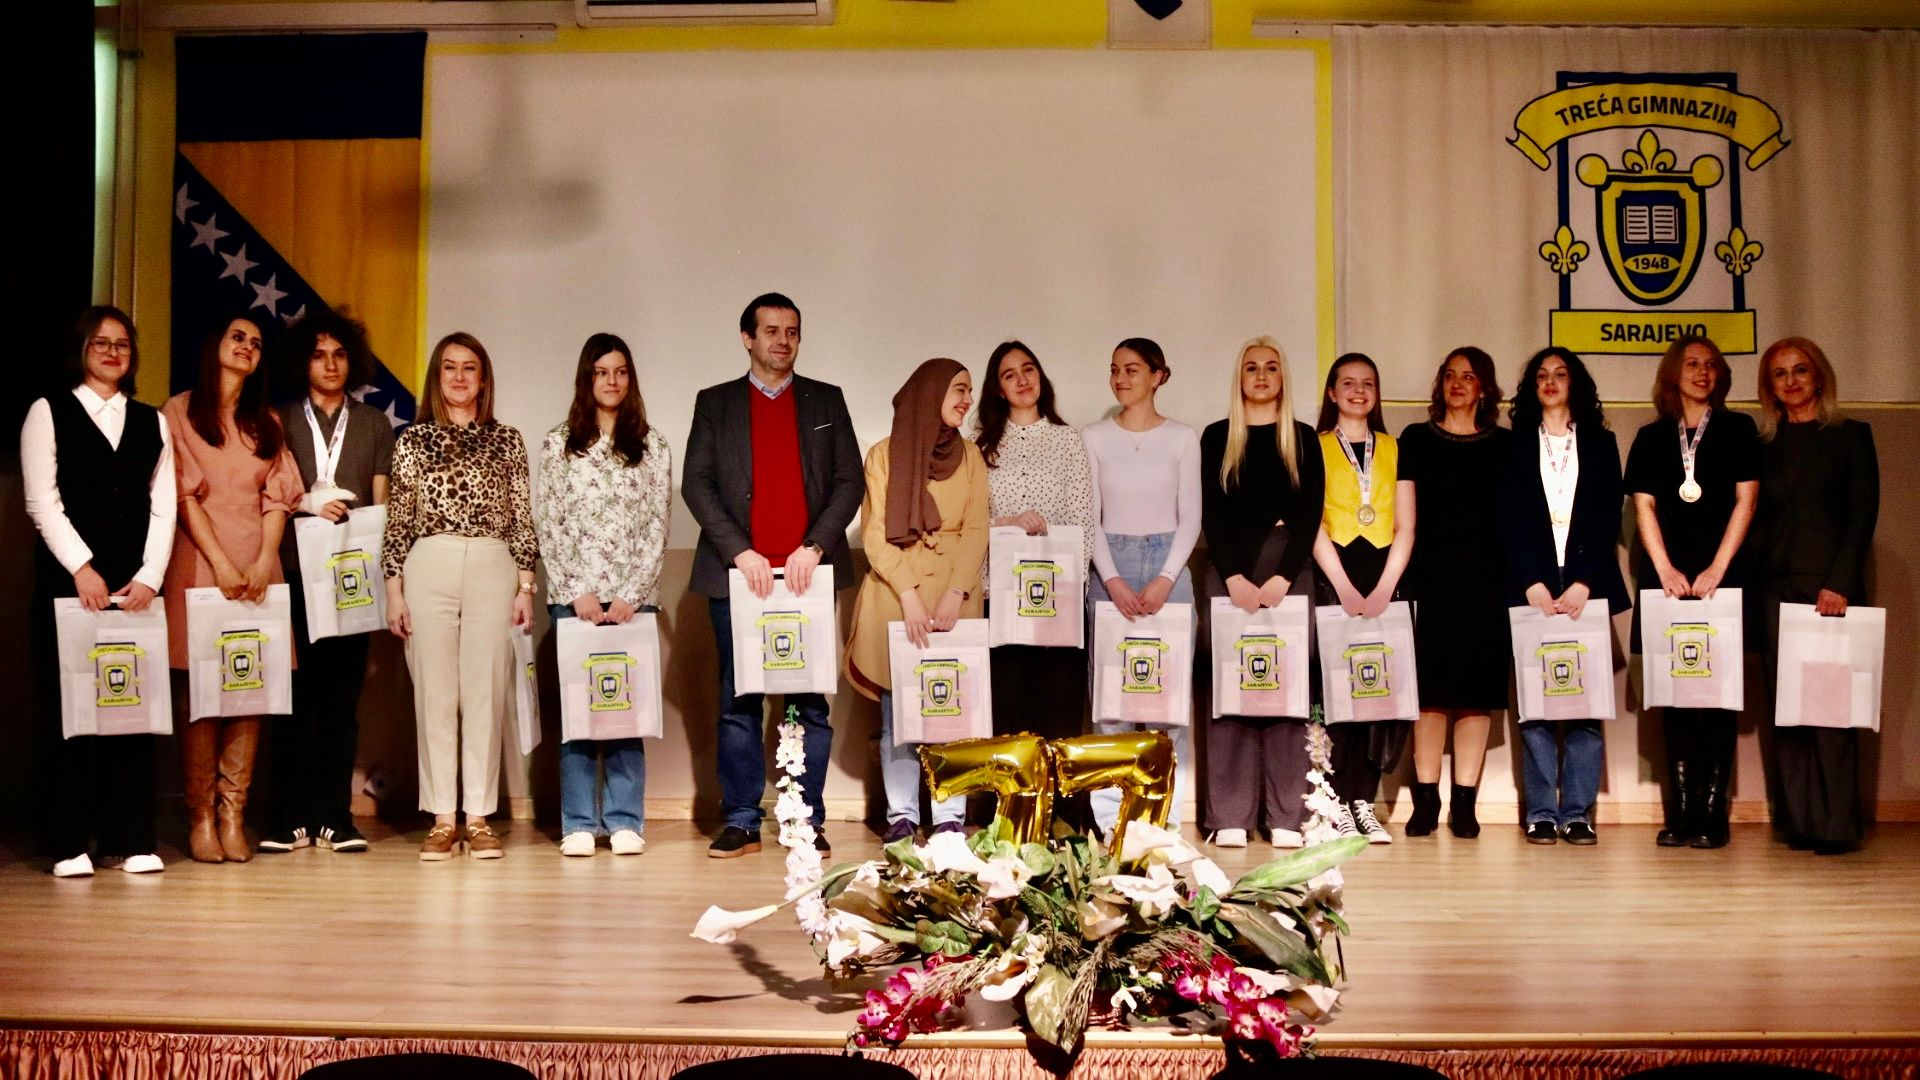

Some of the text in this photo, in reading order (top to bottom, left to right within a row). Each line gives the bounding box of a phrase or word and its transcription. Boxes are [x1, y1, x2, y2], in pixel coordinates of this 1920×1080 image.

[1555, 93, 1738, 128] TREĆA GIMNAZIJA
[1632, 256, 1670, 270] 1948
[1600, 323, 1707, 342] SARAJEVO
